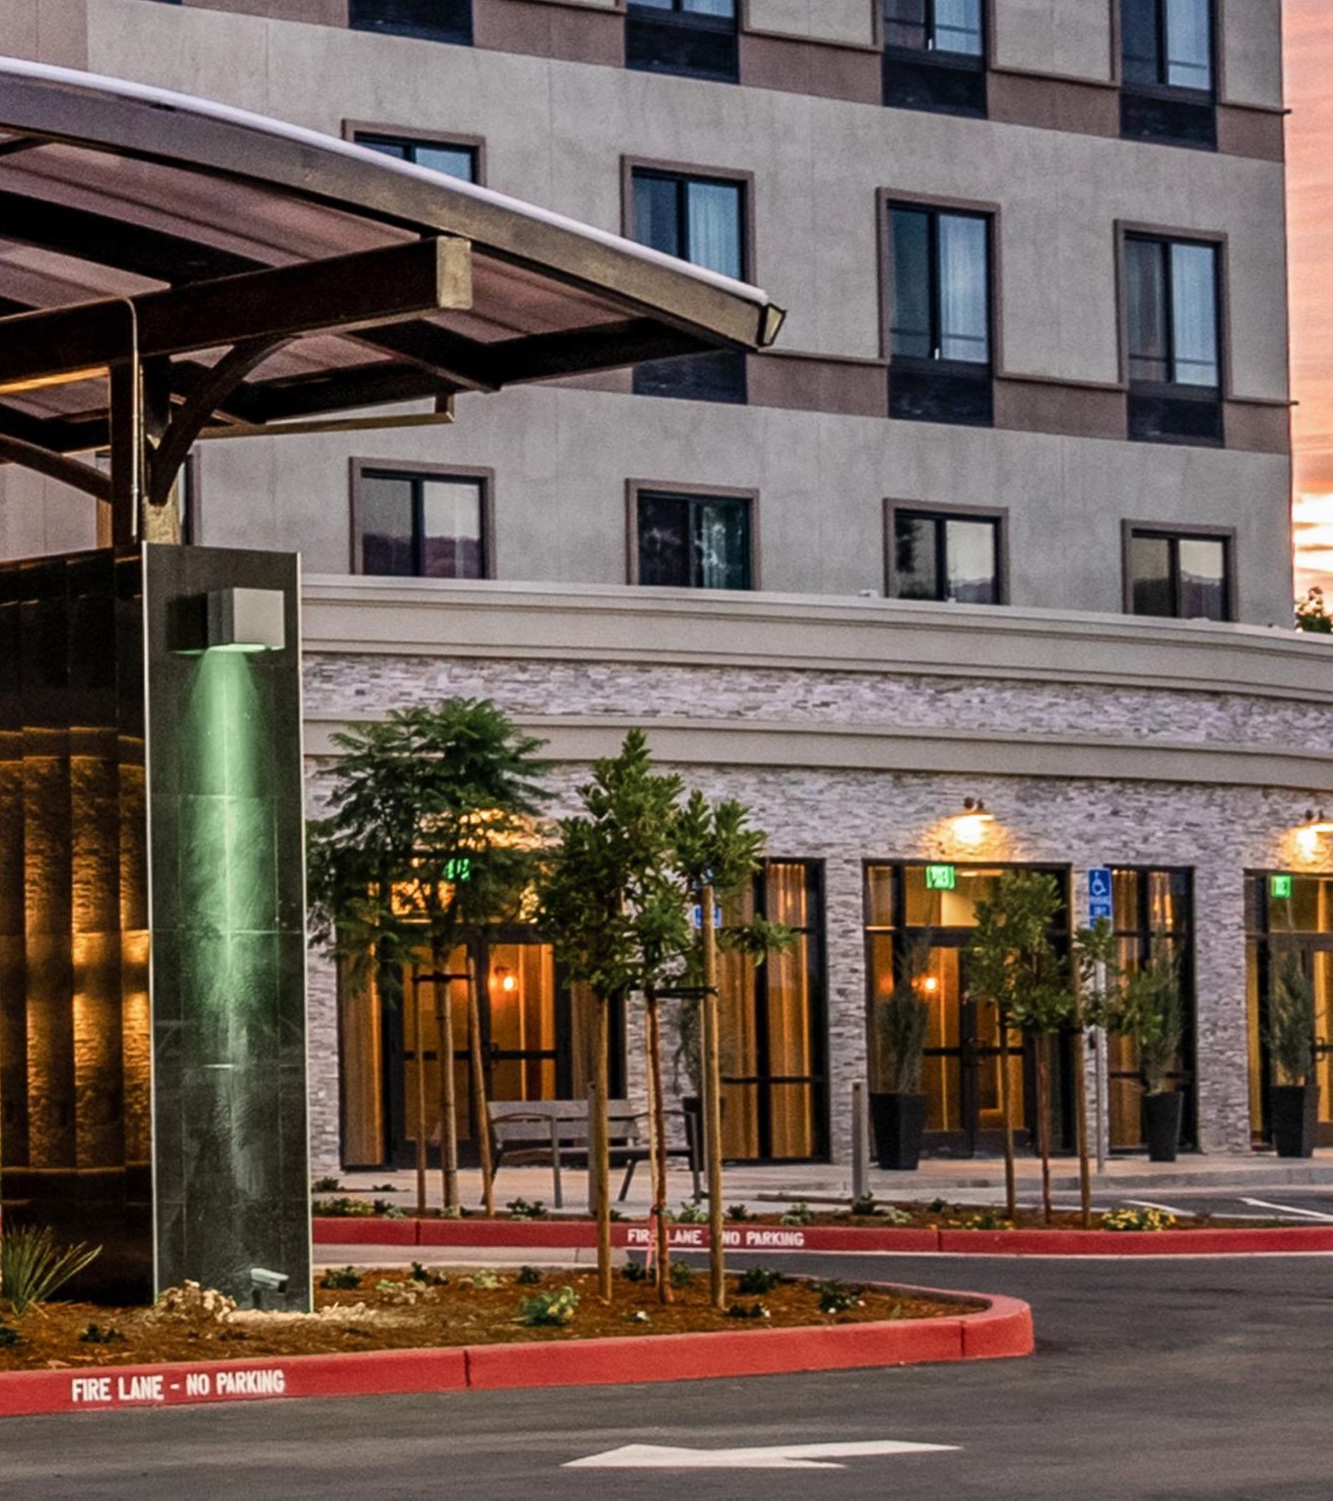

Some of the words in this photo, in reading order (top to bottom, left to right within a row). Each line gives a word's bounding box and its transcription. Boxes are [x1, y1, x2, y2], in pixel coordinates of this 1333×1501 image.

[721, 1231, 740, 1245] NO
[746, 1231, 805, 1246] PARKING
[72, 1378, 112, 1402] FIRE
[118, 1375, 165, 1401] LANE
[186, 1373, 210, 1396] NO
[216, 1369, 285, 1394] PARKING
